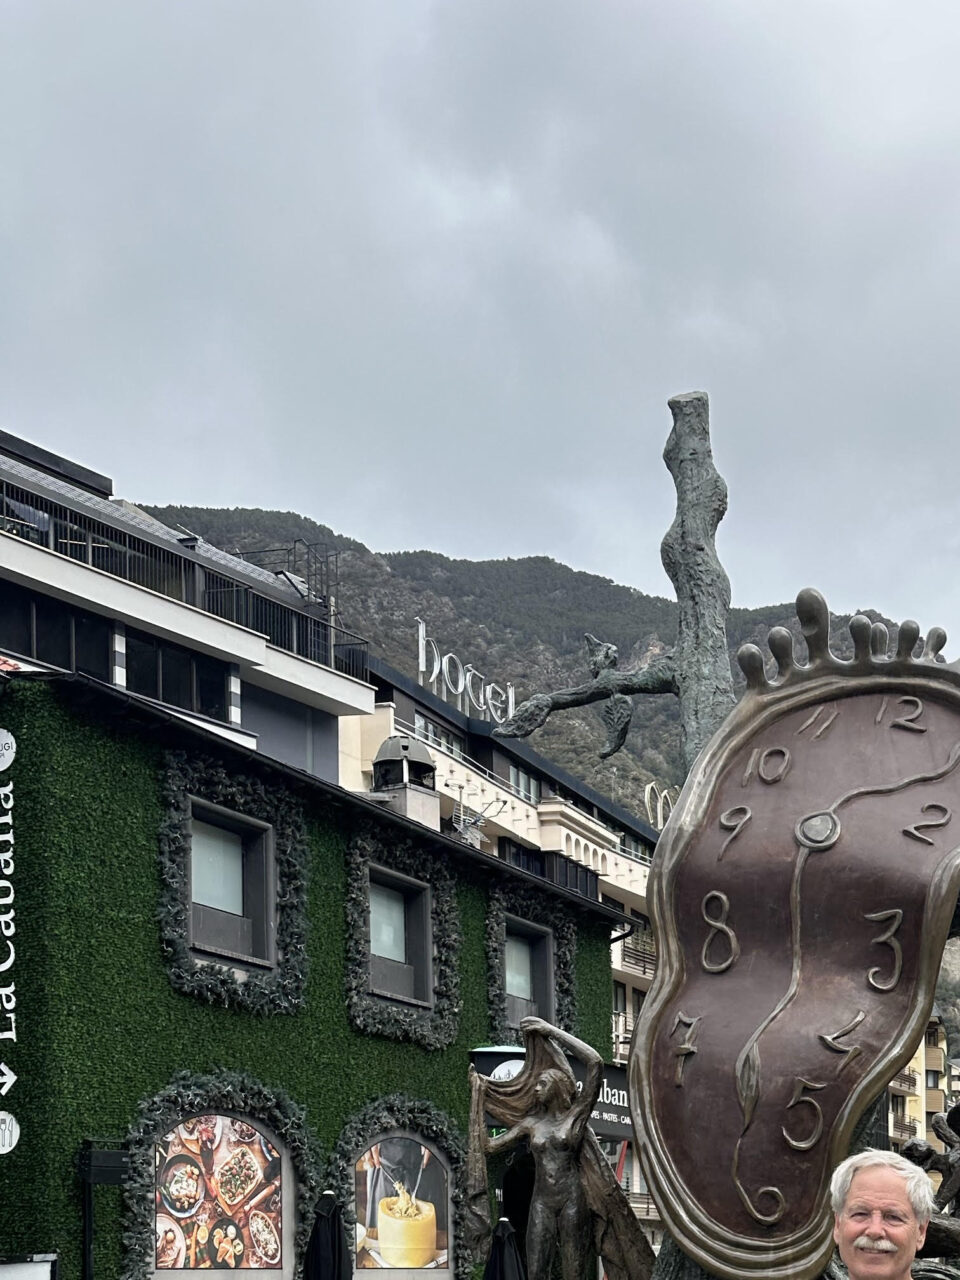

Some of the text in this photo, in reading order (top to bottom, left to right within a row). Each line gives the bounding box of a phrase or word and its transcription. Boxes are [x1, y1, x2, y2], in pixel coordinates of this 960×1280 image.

[413, 616, 515, 723] hotel
[875, 695, 927, 734] 12
[742, 747, 791, 788] 10
[718, 805, 752, 862] 9
[902, 803, 952, 845] 2
[702, 890, 740, 973] 8
[864, 908, 903, 991] 3
[670, 1011, 701, 1088] 7
[782, 1076, 827, 1150] 5
